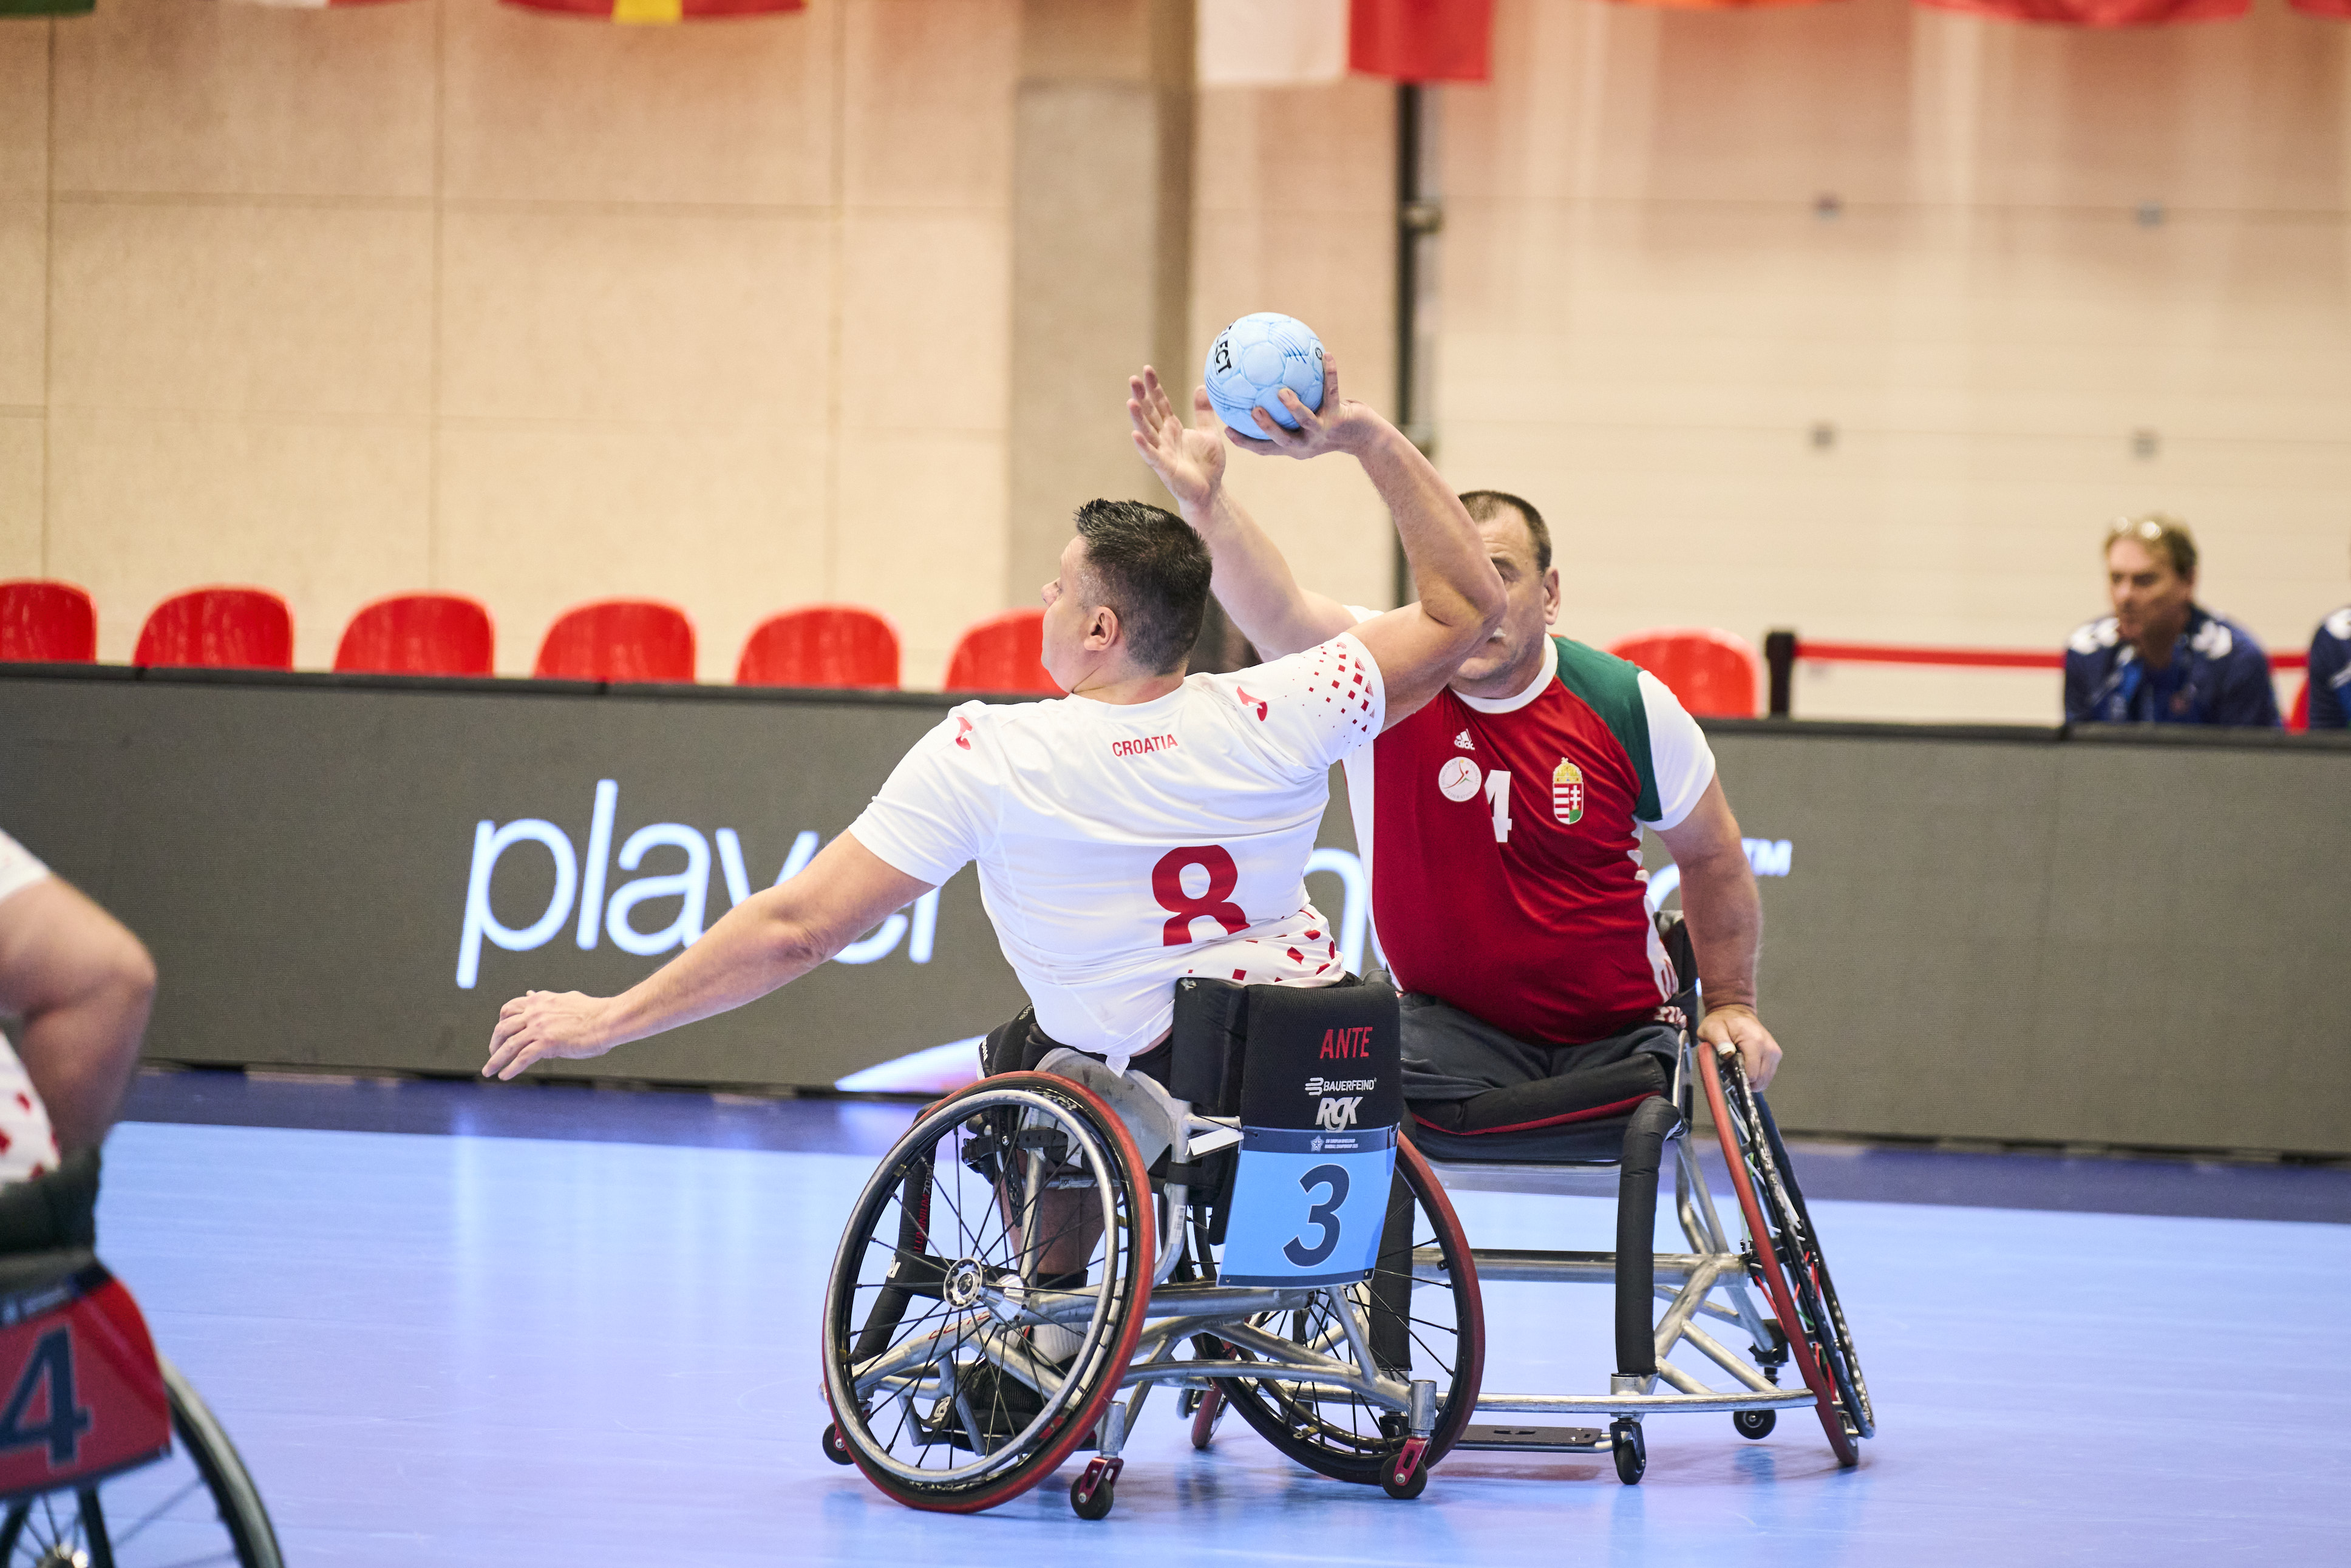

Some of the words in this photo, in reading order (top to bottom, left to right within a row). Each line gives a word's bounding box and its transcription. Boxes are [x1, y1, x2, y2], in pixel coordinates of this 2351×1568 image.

[1112, 734, 1179, 757] CROATIA
[1484, 769, 1512, 843] 4
[1151, 844, 1251, 947] 8
[1319, 1026, 1373, 1059] ANTE
[1323, 1079, 1375, 1091] BAUERFEIND
[1315, 1096, 1364, 1133] RGK
[1283, 1163, 1350, 1268] 3
[0, 1326, 91, 1467] 4
